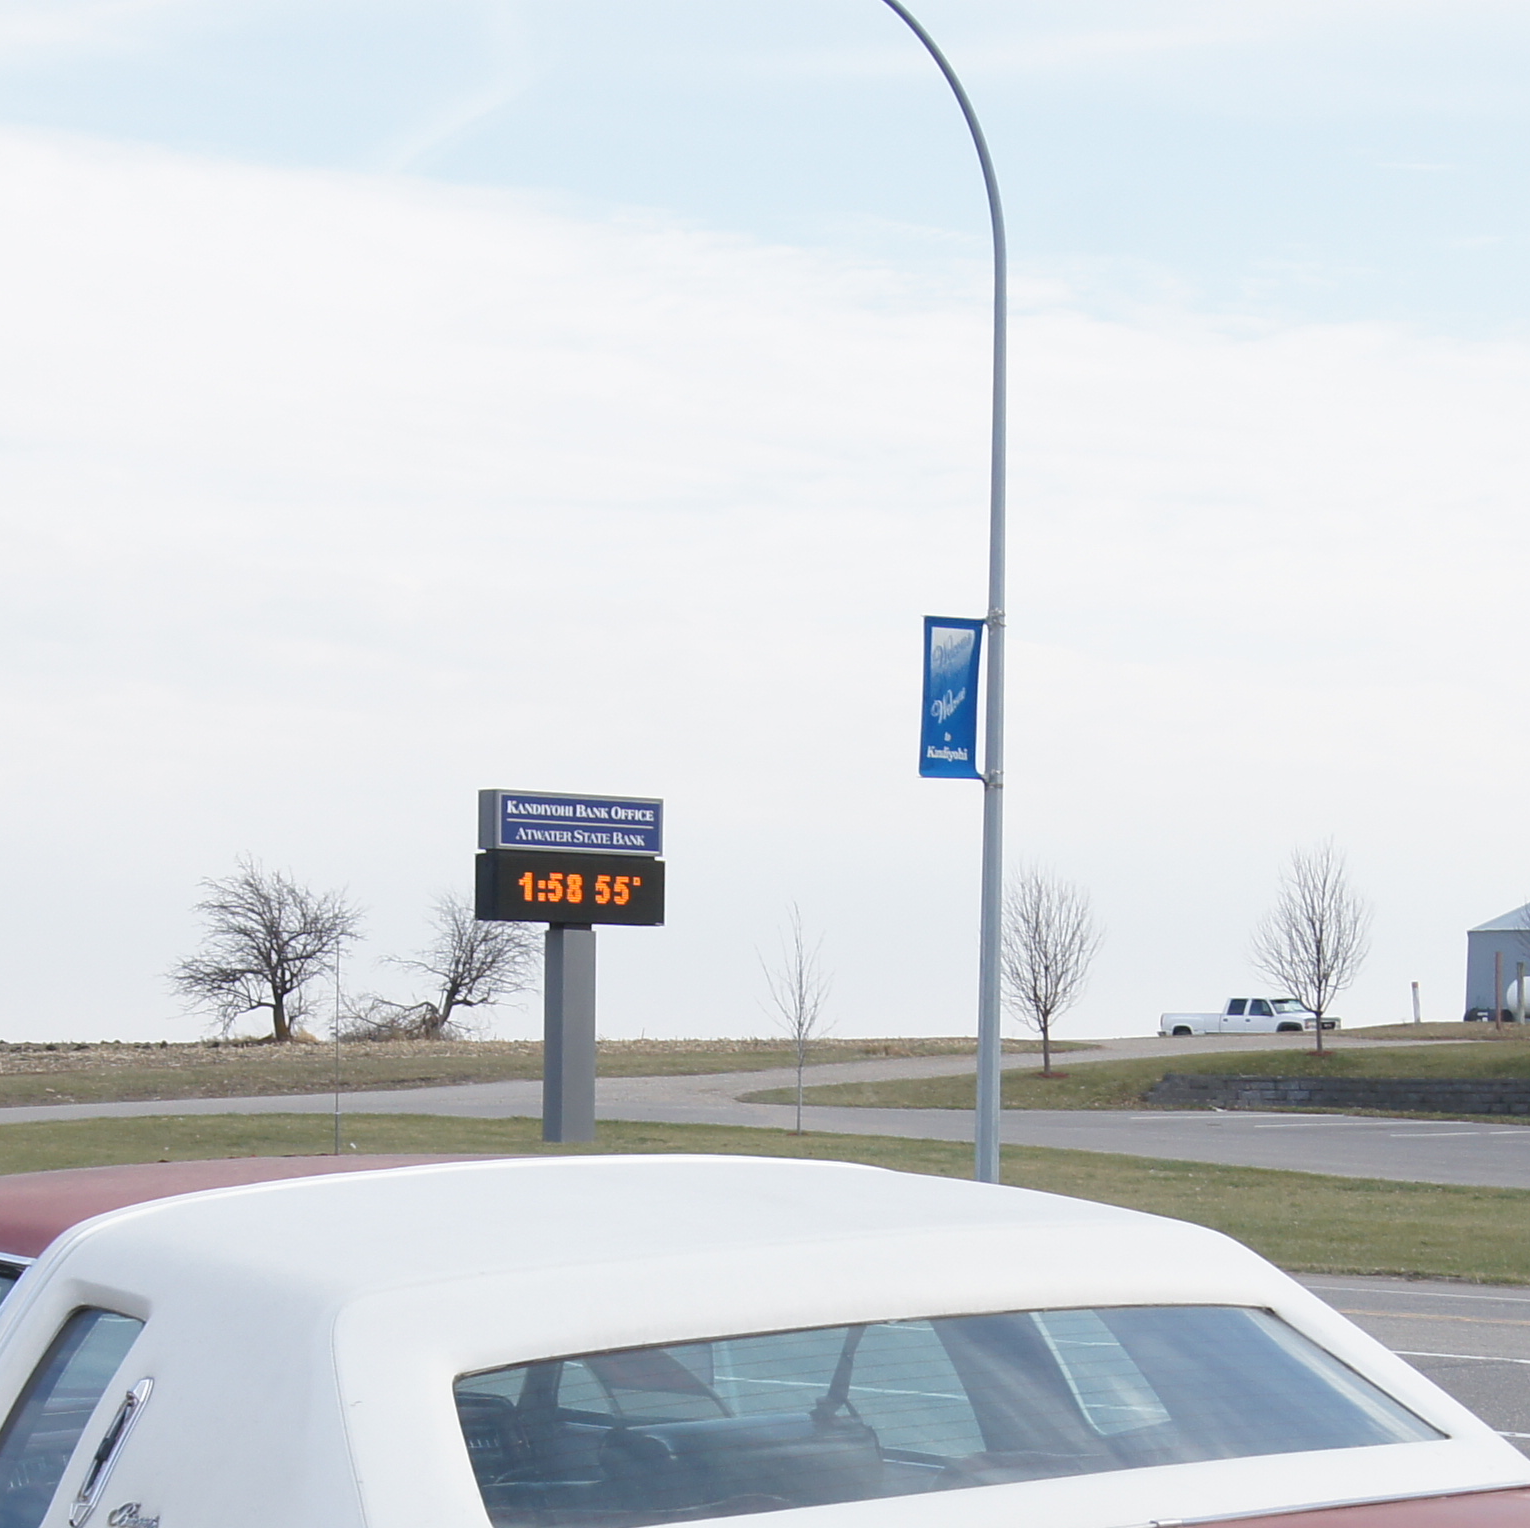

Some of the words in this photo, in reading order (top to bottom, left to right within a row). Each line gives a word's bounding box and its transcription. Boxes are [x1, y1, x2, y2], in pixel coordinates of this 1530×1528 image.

[506, 800, 573, 817] KANDIYOHI
[575, 804, 609, 819] BANK
[610, 806, 654, 821] OFFICE
[515, 827, 572, 843] ATWATER
[573, 829, 611, 845] STATE
[612, 832, 645, 847] BANK
[518, 872, 583, 904] 1:58
[595, 874, 642, 906] 55°
